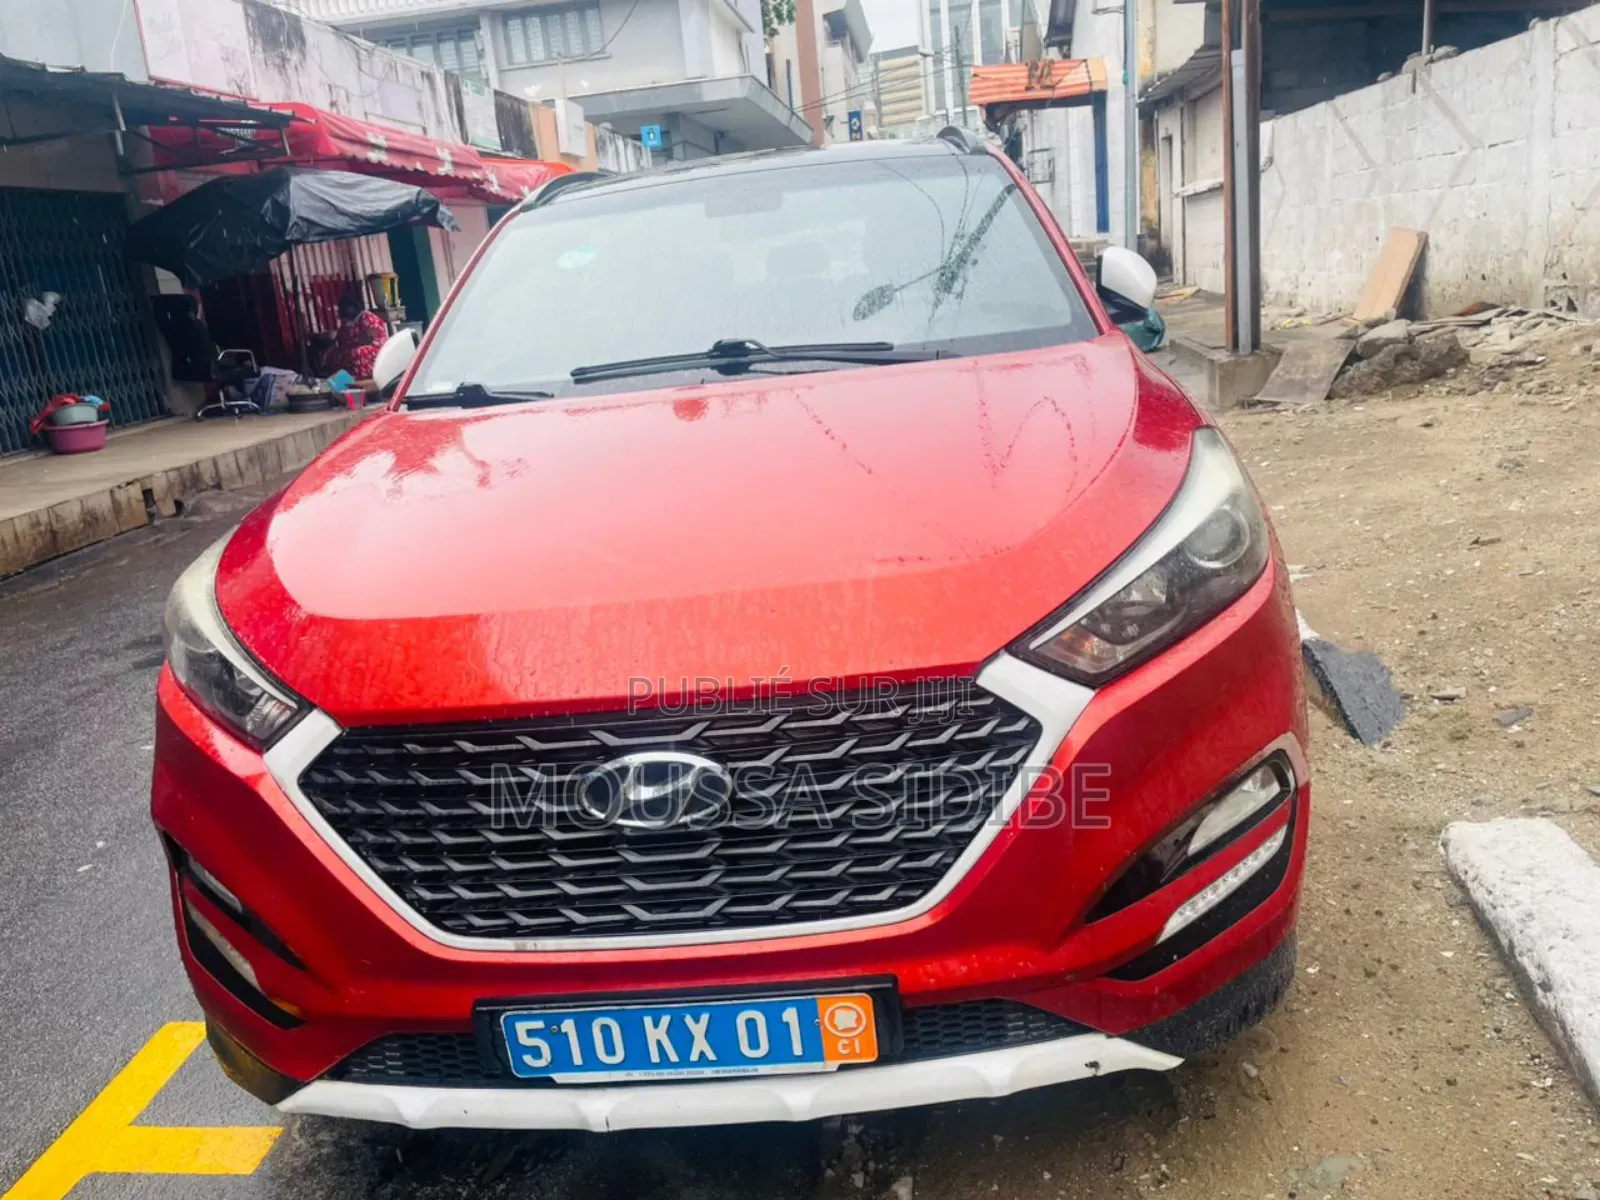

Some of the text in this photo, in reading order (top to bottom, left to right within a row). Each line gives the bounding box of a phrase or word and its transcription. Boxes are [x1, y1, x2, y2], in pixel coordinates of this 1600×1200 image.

[515, 1006, 805, 1068] 510 KX 01
[836, 1038, 861, 1056] CI
